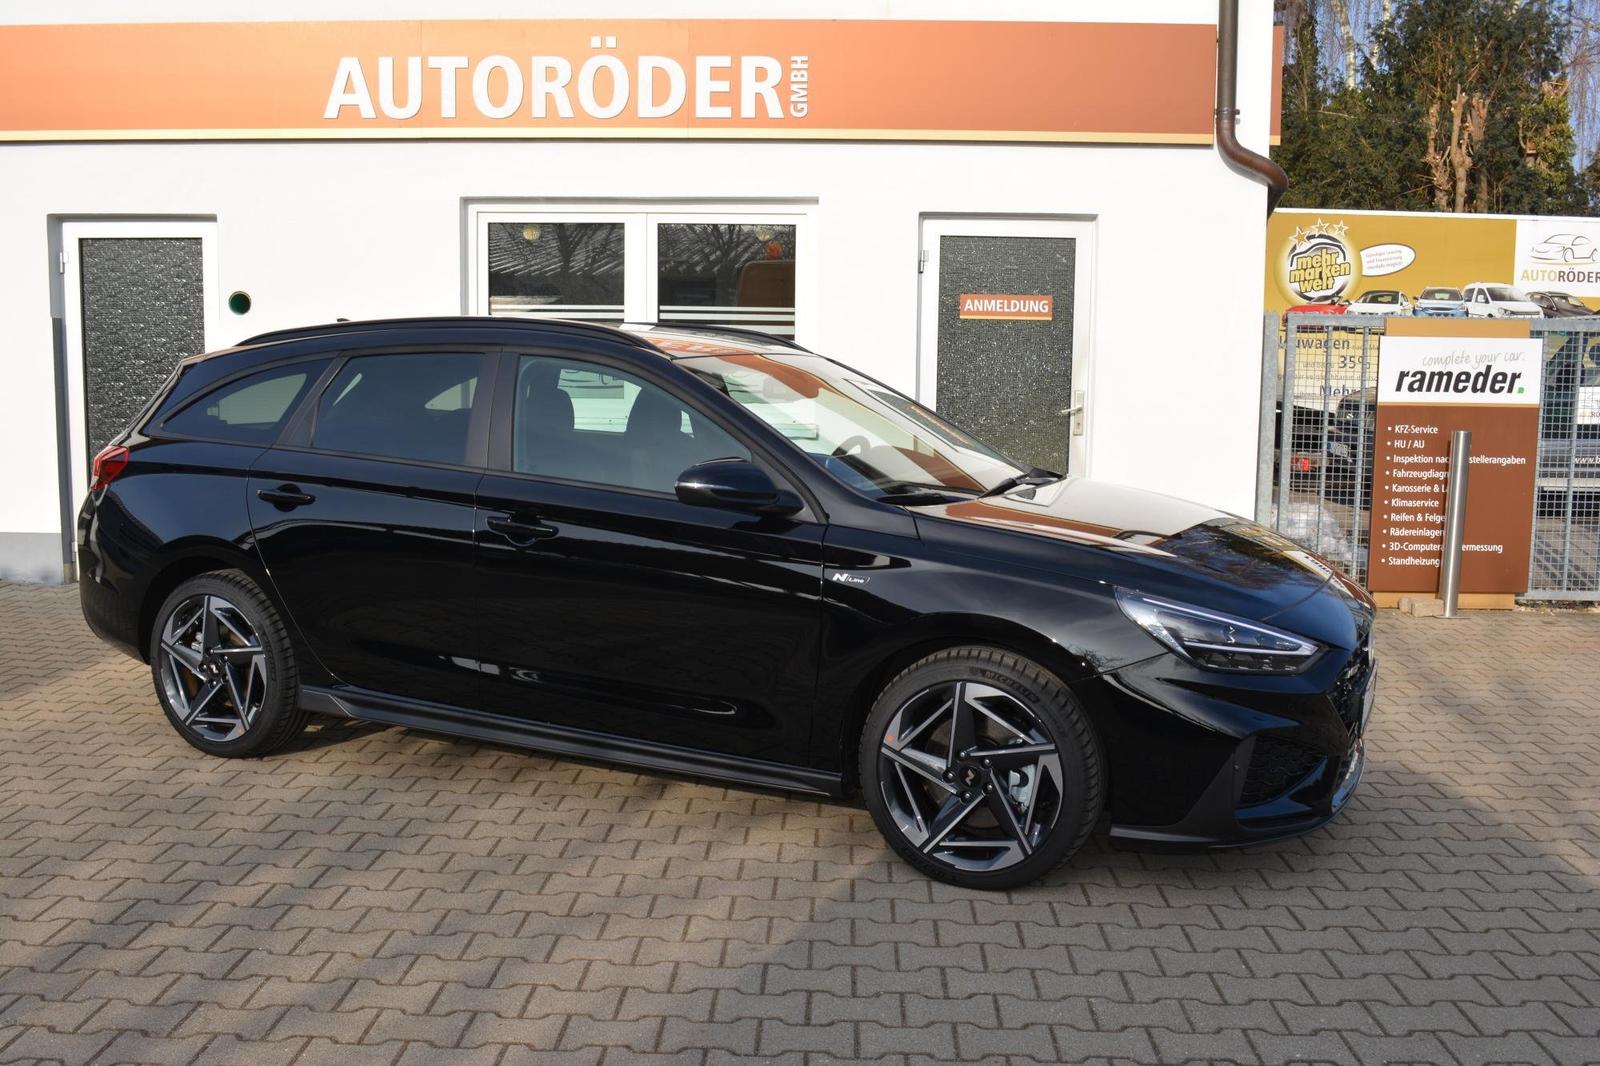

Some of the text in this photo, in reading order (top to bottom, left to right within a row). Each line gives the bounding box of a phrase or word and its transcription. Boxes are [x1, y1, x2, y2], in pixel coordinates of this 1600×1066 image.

[323, 35, 809, 119] AUTORÖDER GMBH
[1296, 248, 1339, 270] mehr
[1289, 261, 1351, 283] marken
[1521, 267, 1600, 283] AUTORÖDER
[1300, 275, 1335, 293] welt
[964, 299, 1049, 313] ANMELDUNG
[1422, 350, 1472, 370] complete
[1472, 353, 1500, 370] your
[1395, 425, 1439, 434] KFZ-Service
[1394, 440, 1406, 449] HU
[1413, 440, 1425, 449] AU
[1393, 454, 1433, 465] Inspektion
[1435, 455, 1449, 464] nac
[1392, 468, 1450, 480] Fahrzeugdiagn
[1392, 483, 1432, 493] Karosserie
[1433, 484, 1440, 493] &
[1391, 497, 1440, 508] Klimaservice
[1390, 512, 1446, 524] Reifen & Felge
[1389, 527, 1445, 539] Rädereinlager
[1388, 556, 1441, 568] Standheizung
